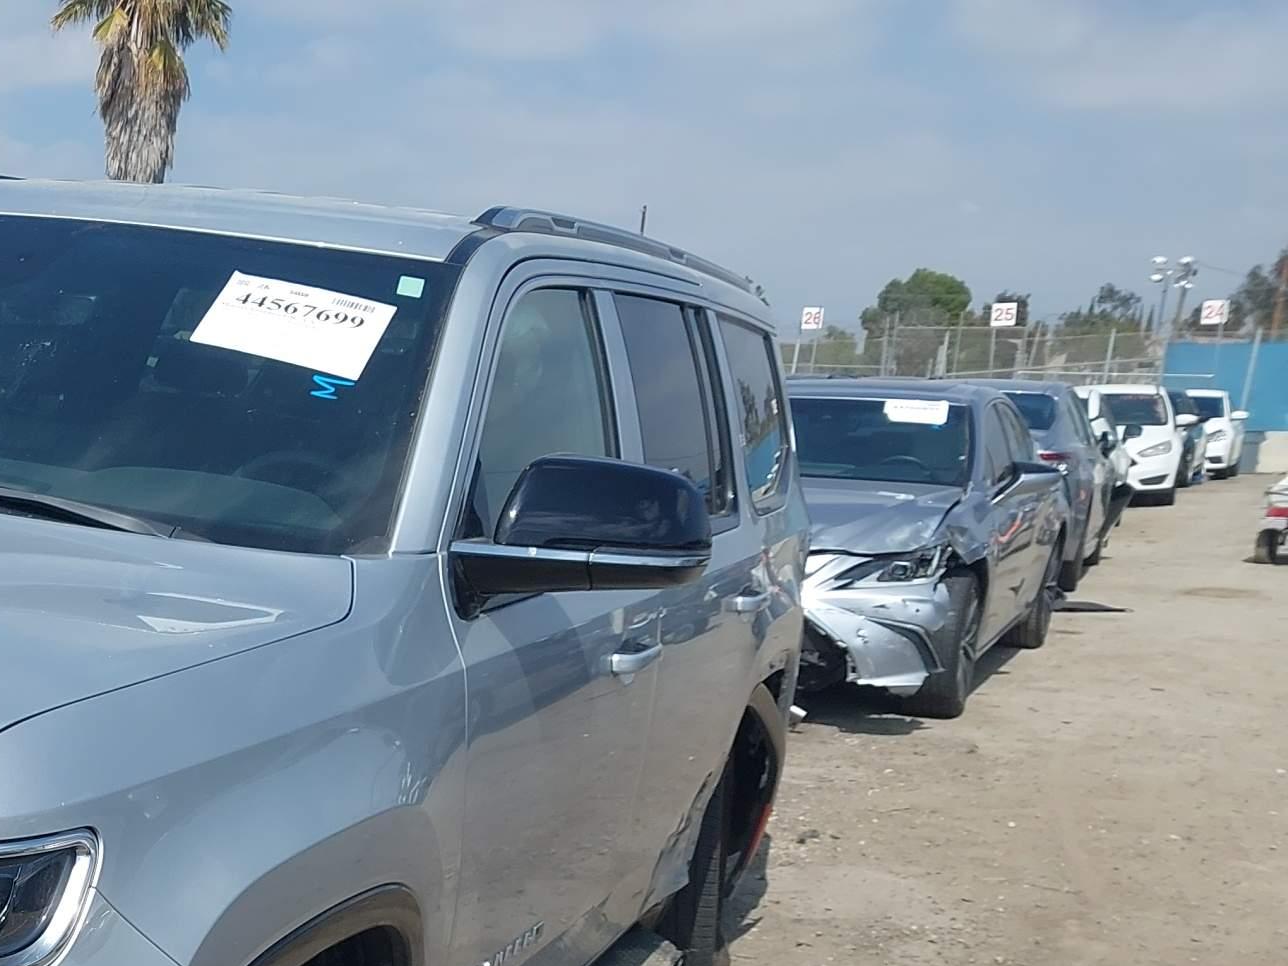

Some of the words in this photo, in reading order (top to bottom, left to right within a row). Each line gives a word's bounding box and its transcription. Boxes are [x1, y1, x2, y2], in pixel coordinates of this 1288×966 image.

[235, 293, 365, 328] 44567699
[994, 308, 1013, 321] 25
[1203, 304, 1224, 319] 24
